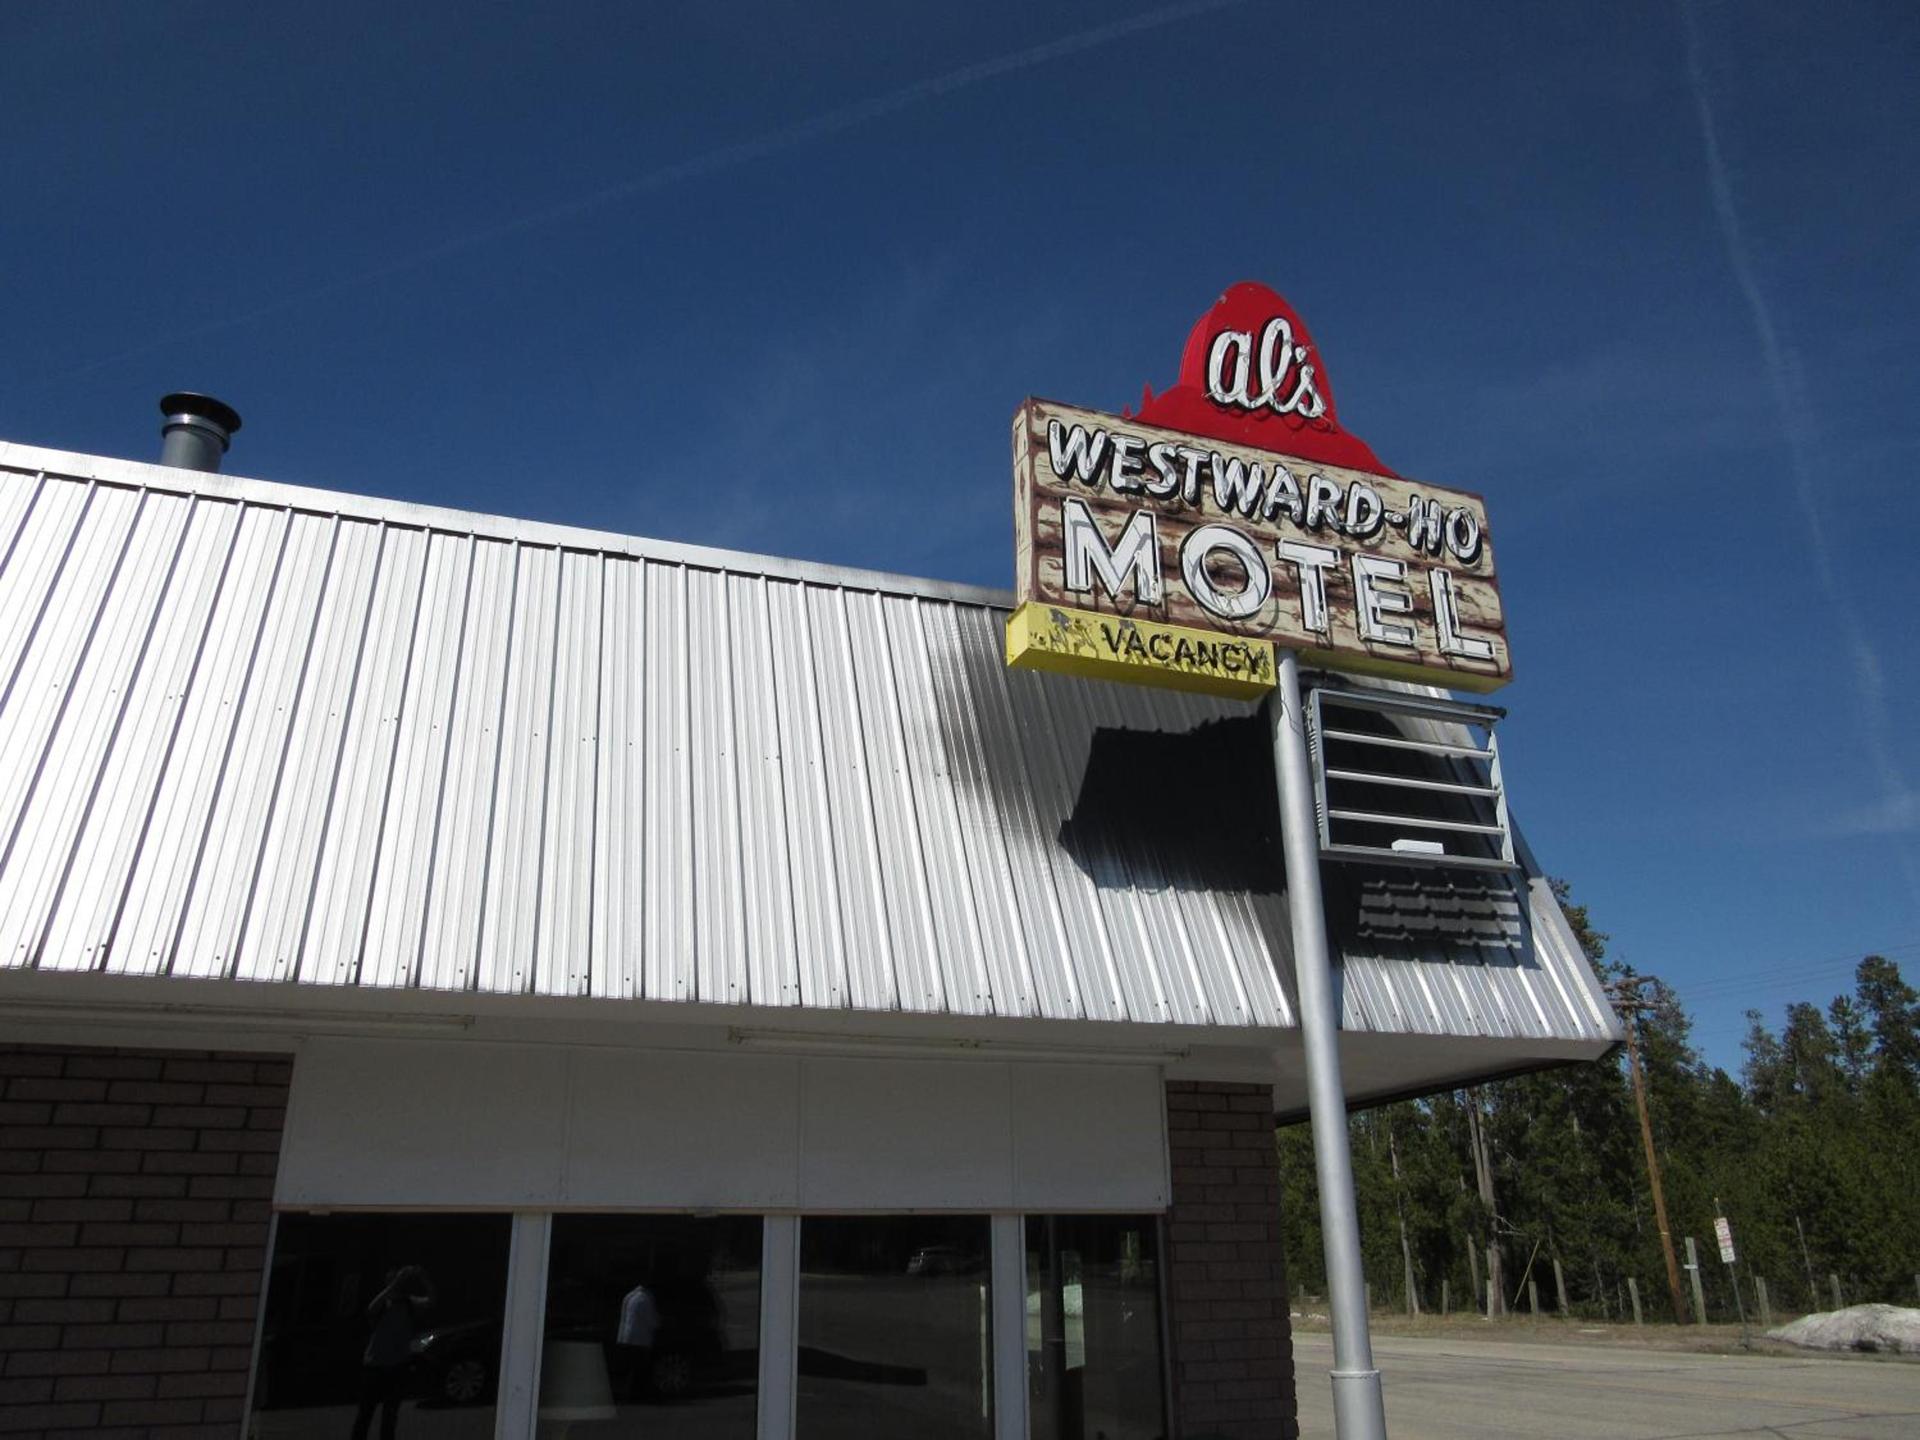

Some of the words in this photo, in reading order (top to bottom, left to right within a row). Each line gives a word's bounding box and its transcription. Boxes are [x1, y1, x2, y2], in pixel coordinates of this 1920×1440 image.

[1048, 419, 1482, 564] WESTWARD-HO
[1062, 496, 1495, 660] MOTEL
[1101, 622, 1268, 675] VACANCY
